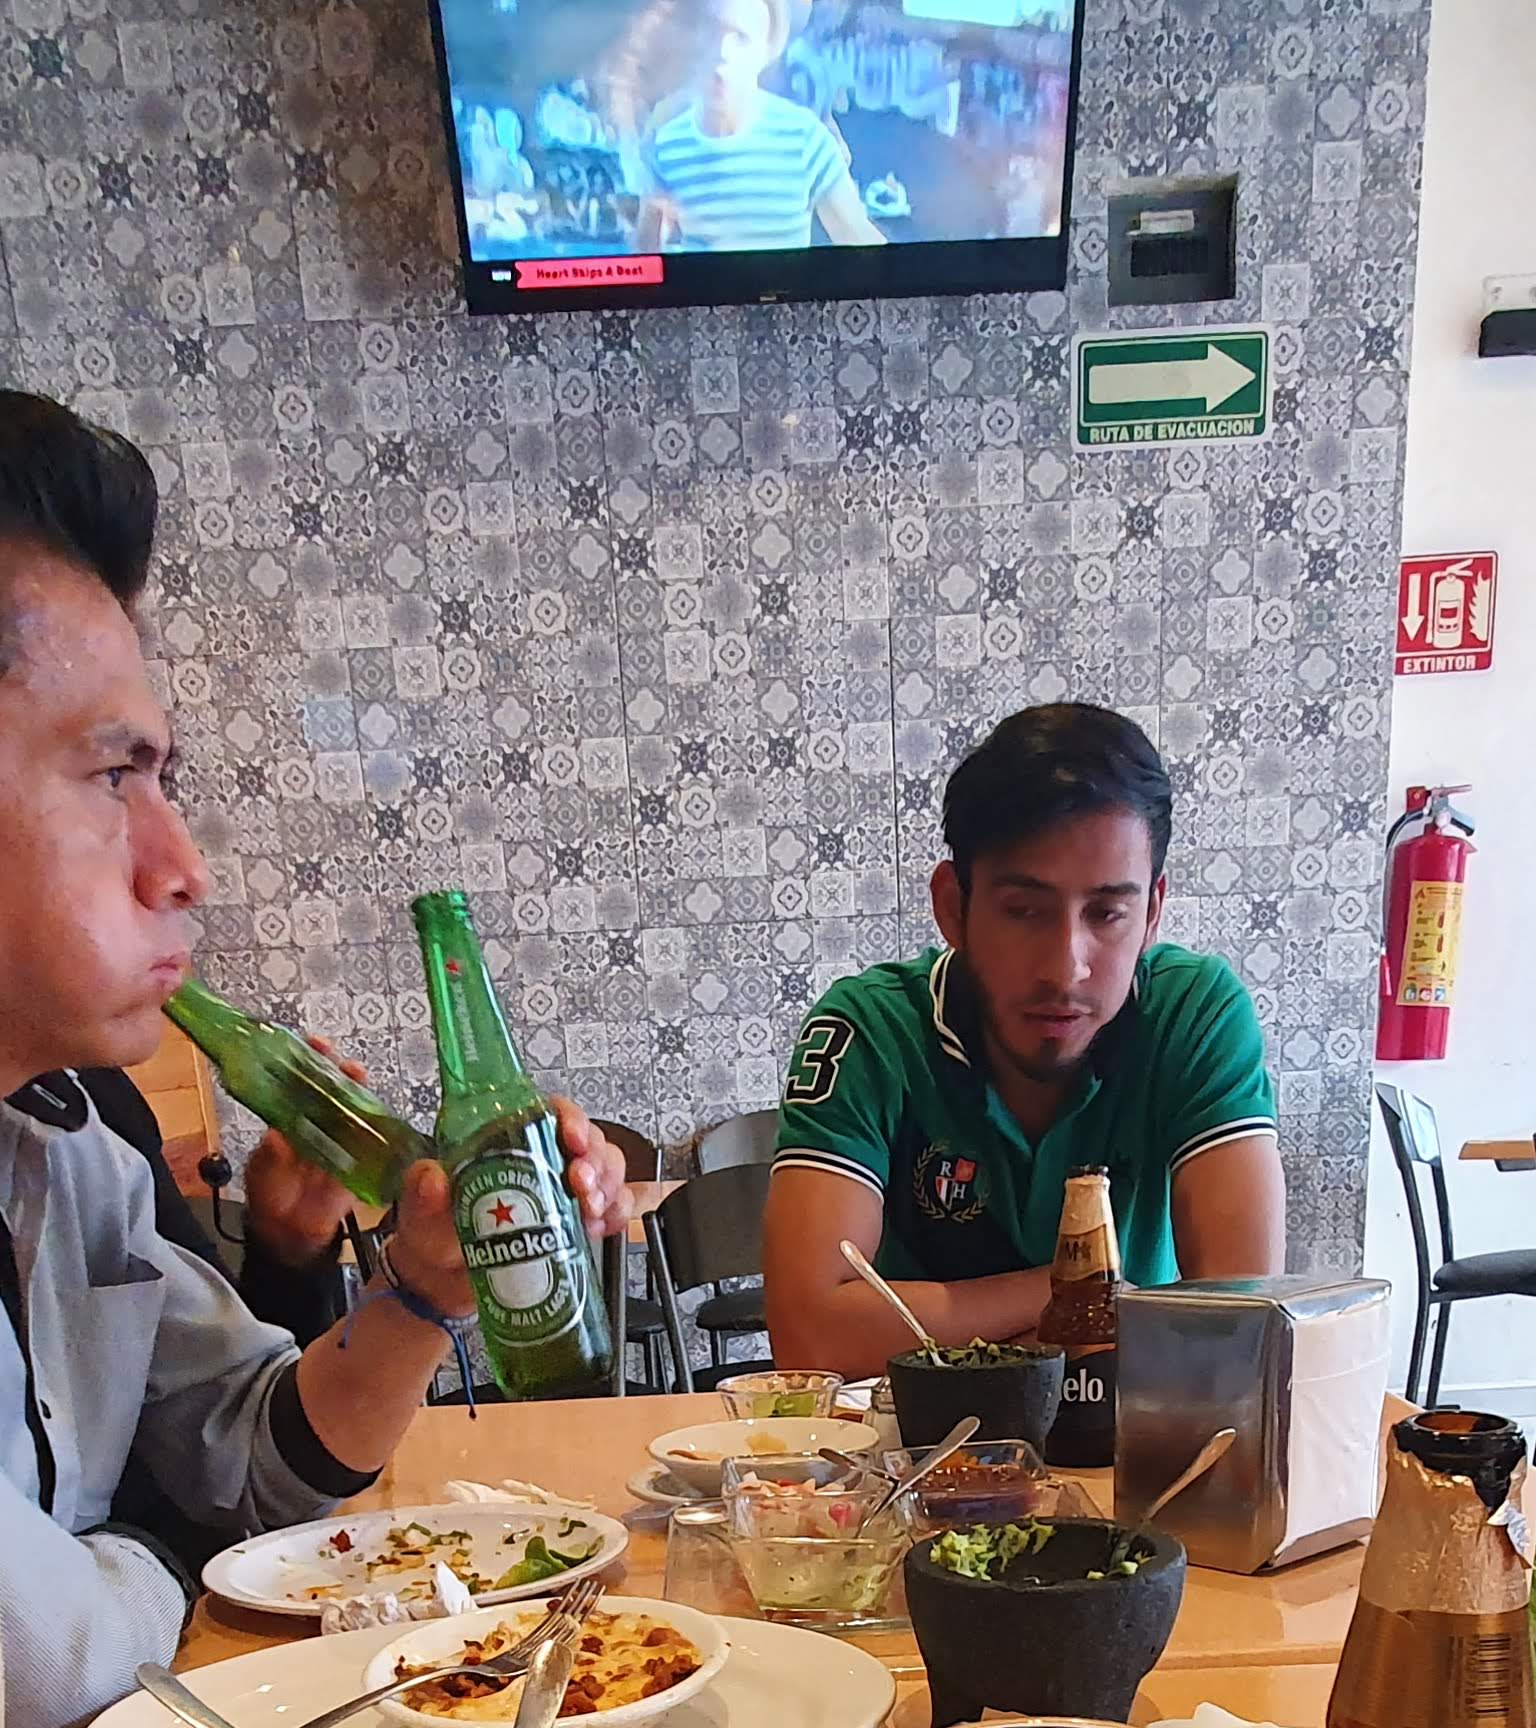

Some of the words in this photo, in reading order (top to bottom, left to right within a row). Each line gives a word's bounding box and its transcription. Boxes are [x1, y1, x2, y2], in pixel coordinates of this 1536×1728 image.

[536, 268, 569, 280] Heart
[616, 265, 644, 276] Beat
[1089, 426, 1129, 443] RUTA
[1133, 425, 1153, 441] DE
[1403, 654, 1476, 674] EXTINTOR
[783, 1015, 855, 1105] 3
[939, 1160, 952, 1177] R
[952, 1183, 967, 1199] H
[464, 1228, 572, 1269] Heineken
[511, 1308, 543, 1327] MALT
[1063, 1368, 1105, 1402] elo
